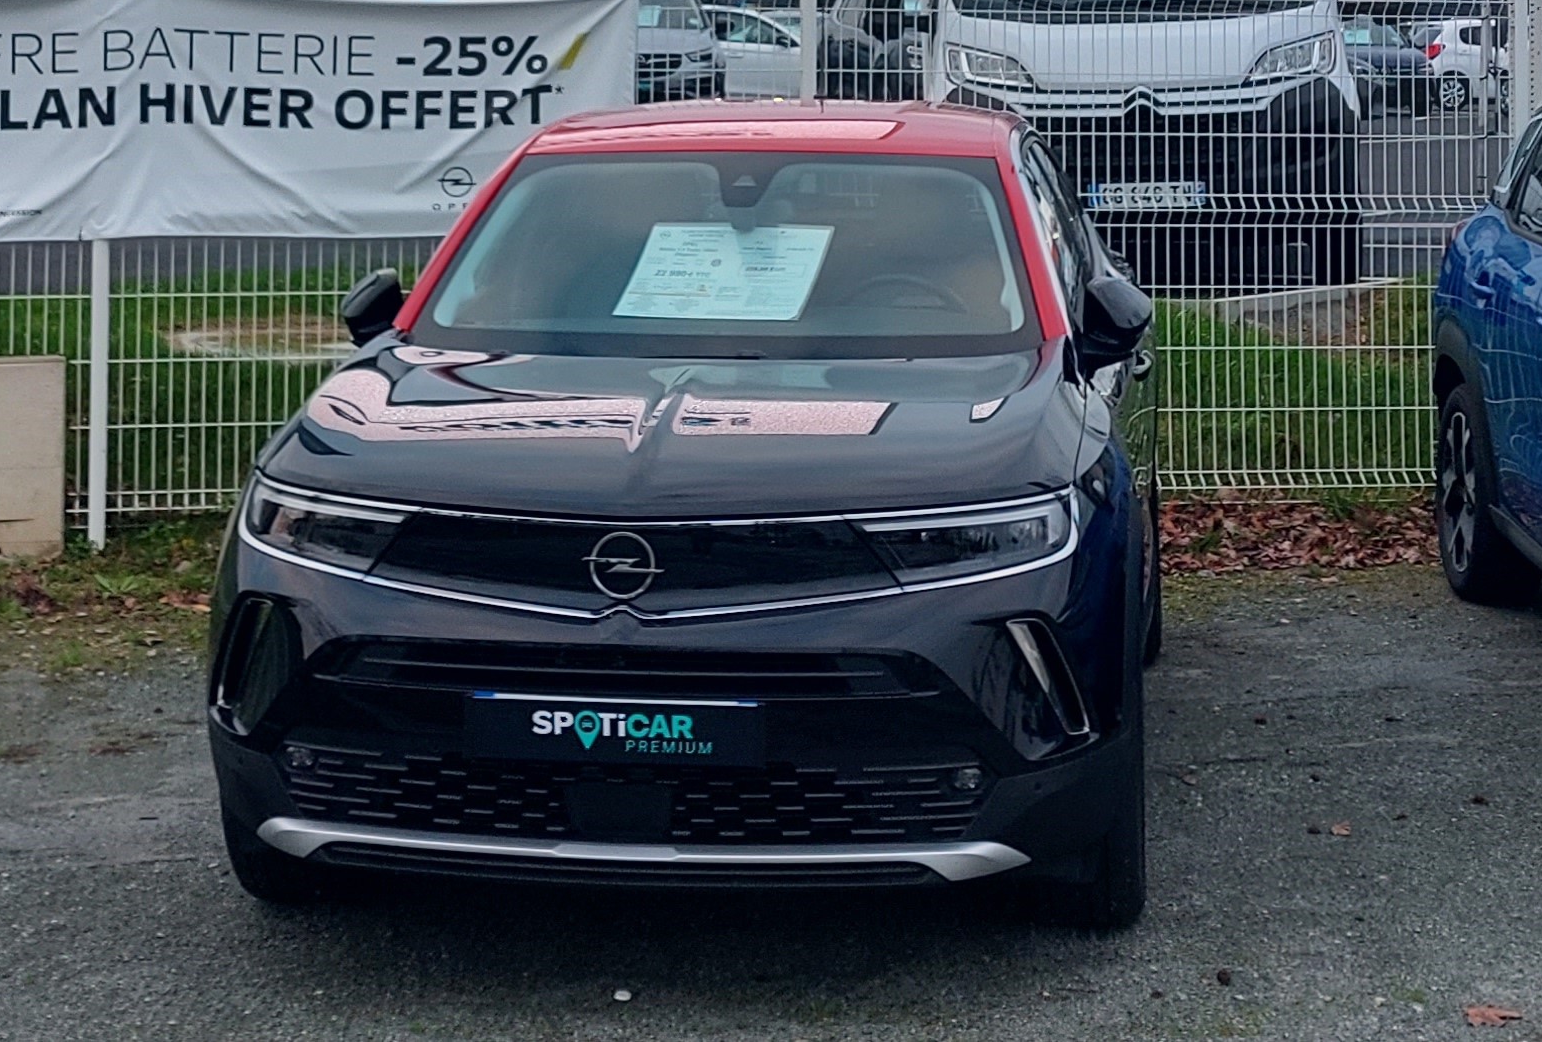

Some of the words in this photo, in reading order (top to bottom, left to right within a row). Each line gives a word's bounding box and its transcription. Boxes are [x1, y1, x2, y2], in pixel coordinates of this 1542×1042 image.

[102, 27, 375, 77] BATTERIE
[396, 35, 548, 78] -25%
[140, 83, 313, 129] HIVER
[432, 203, 468, 211] OPE
[625, 740, 713, 754] PREMIUM
